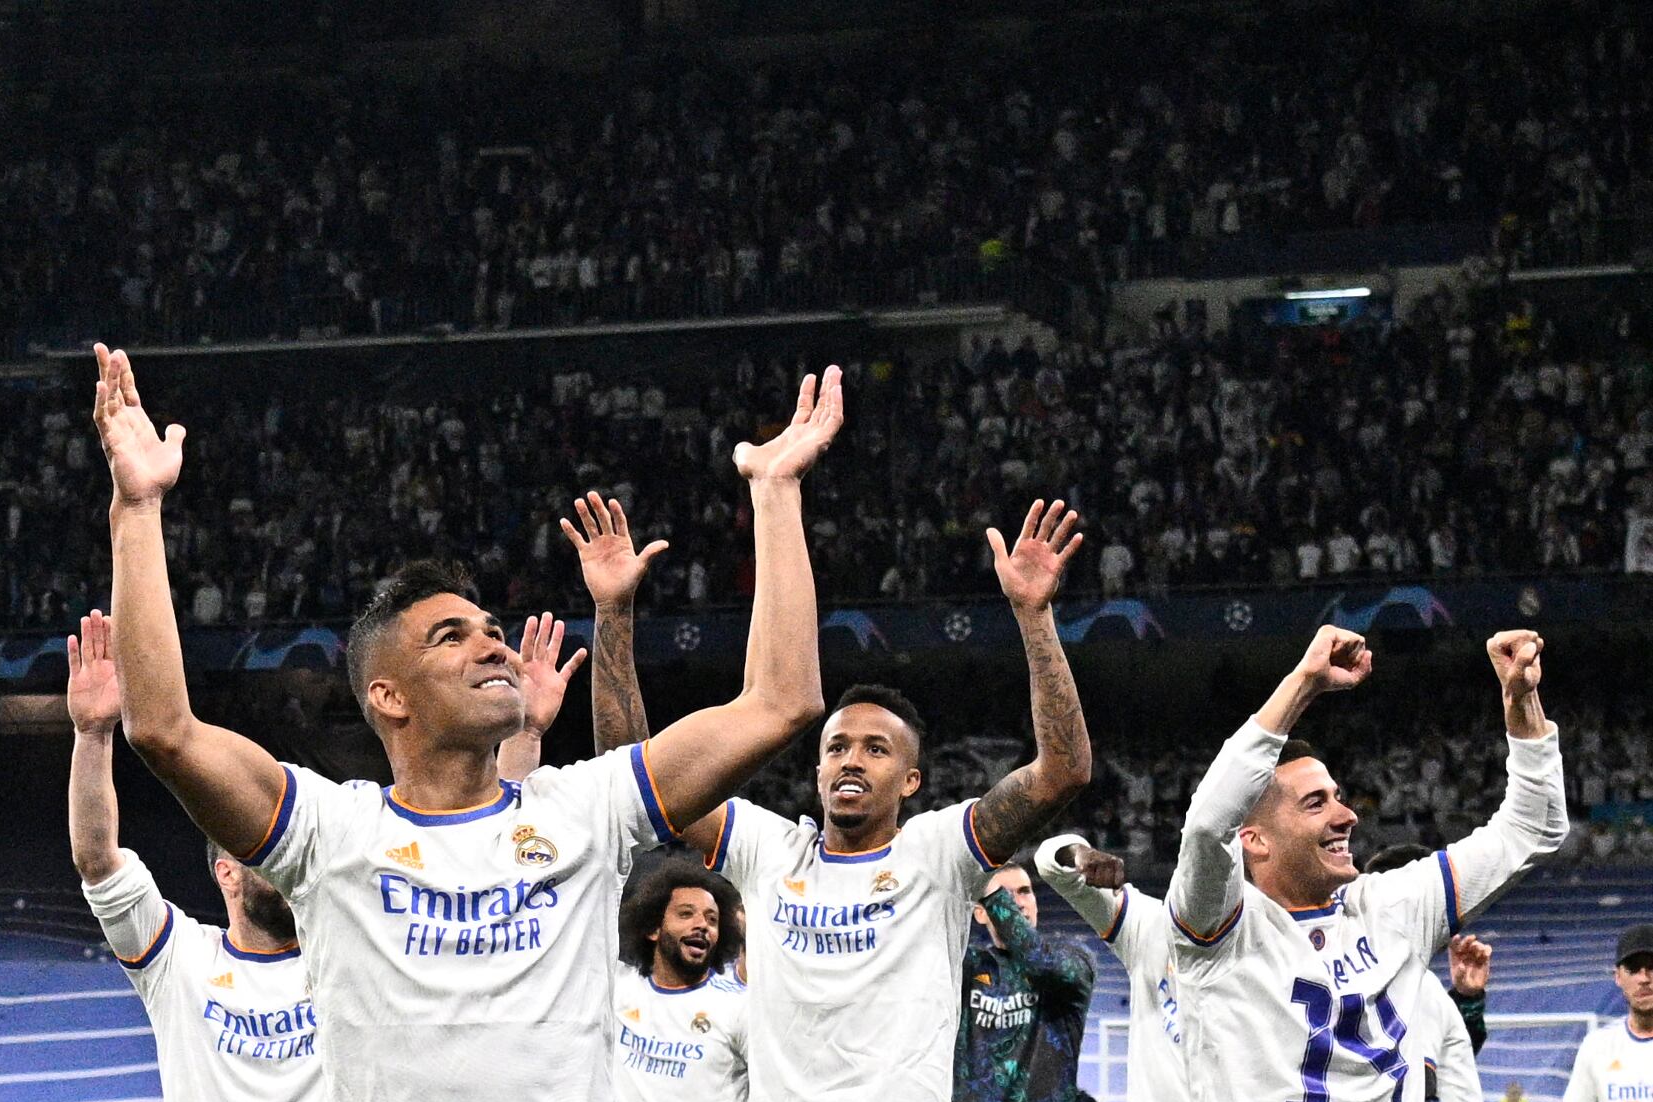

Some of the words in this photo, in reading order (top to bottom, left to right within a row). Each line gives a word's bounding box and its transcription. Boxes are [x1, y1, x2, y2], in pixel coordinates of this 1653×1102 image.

[379, 874, 558, 922] Emirates
[773, 895, 896, 928] Emirates
[405, 923, 447, 955] FLY
[456, 918, 541, 955] BETTER
[782, 930, 808, 953] FLY
[815, 927, 876, 954] BETTER
[204, 998, 317, 1037] Emirate
[970, 990, 1038, 1015] Emiate
[217, 1030, 246, 1055] FLY
[620, 1025, 704, 1060] Emirates
[645, 1057, 687, 1079] BETTER
[1608, 1082, 1653, 1101] Emir
